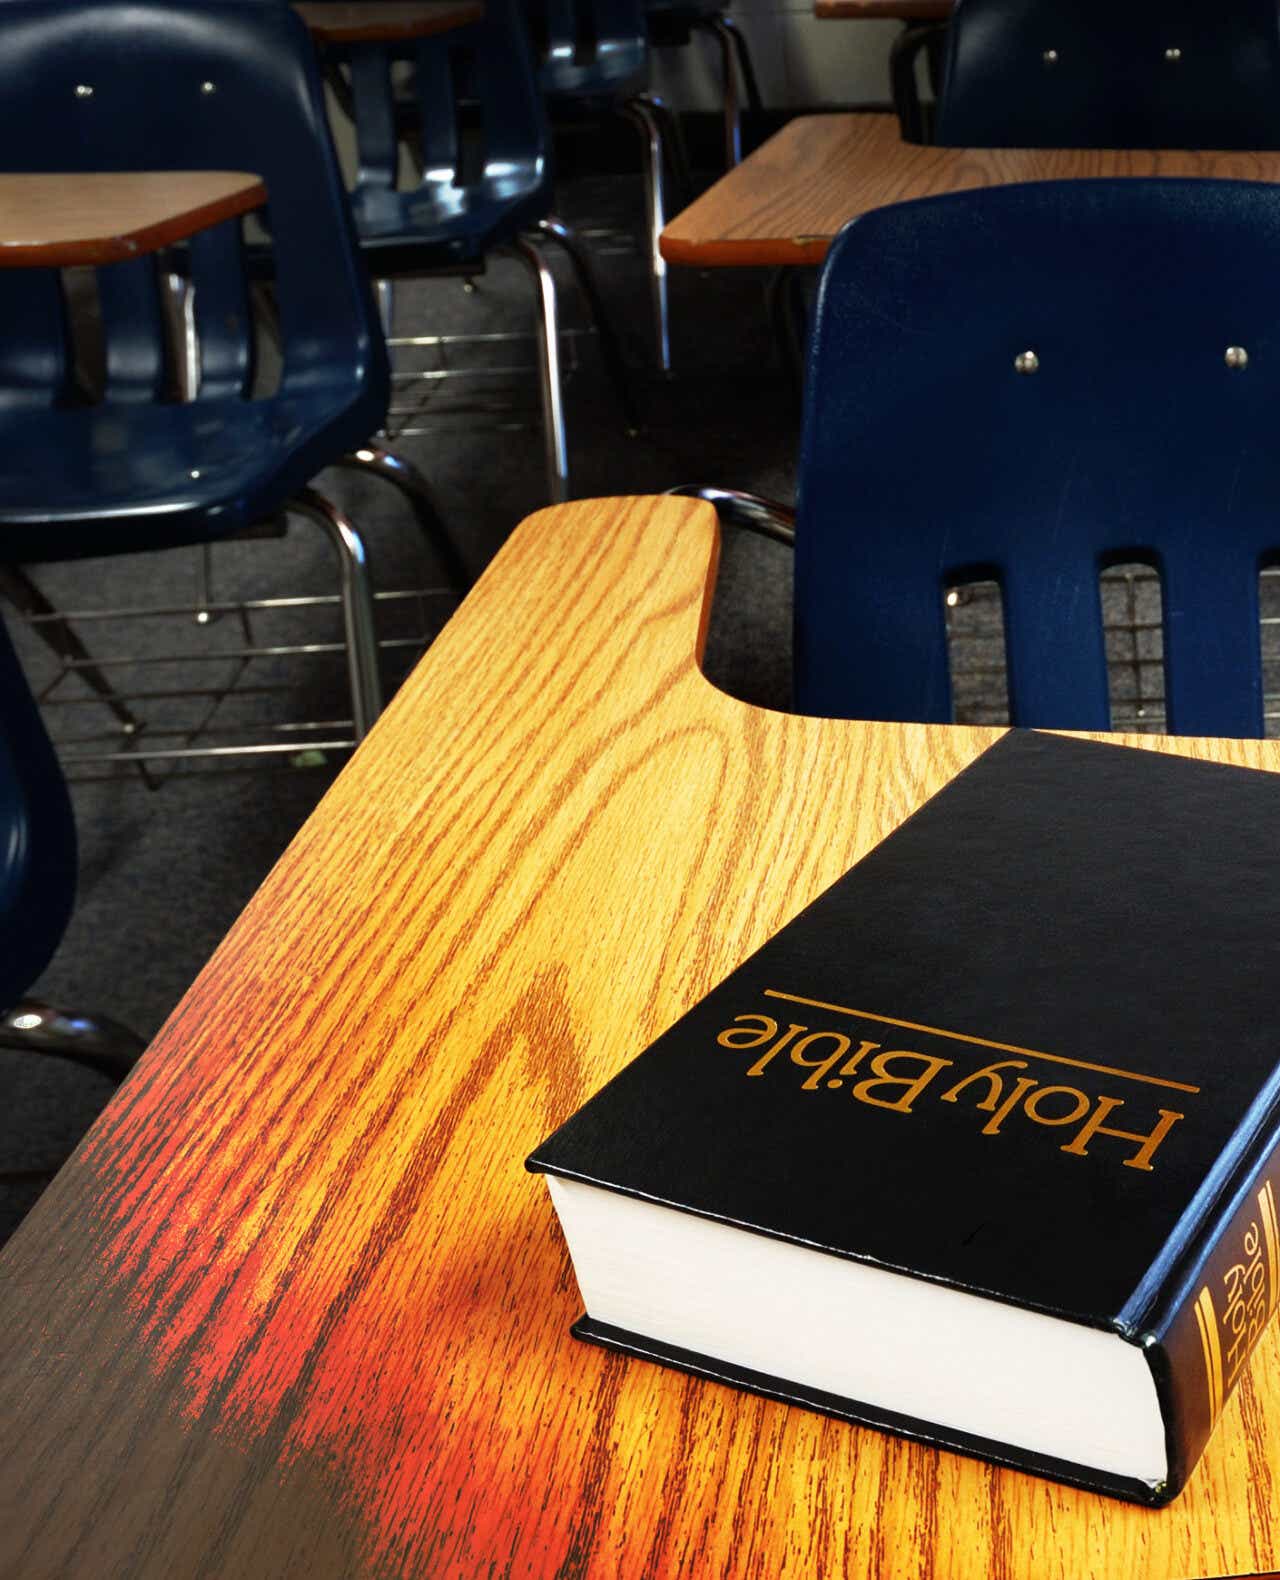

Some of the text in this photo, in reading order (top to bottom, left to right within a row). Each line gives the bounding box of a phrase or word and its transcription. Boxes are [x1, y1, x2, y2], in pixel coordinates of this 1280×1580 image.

[716, 1014, 1185, 1171] Holy Bible
[1223, 1263, 1247, 1388] Holy
[1243, 1222, 1266, 1349] Bible
